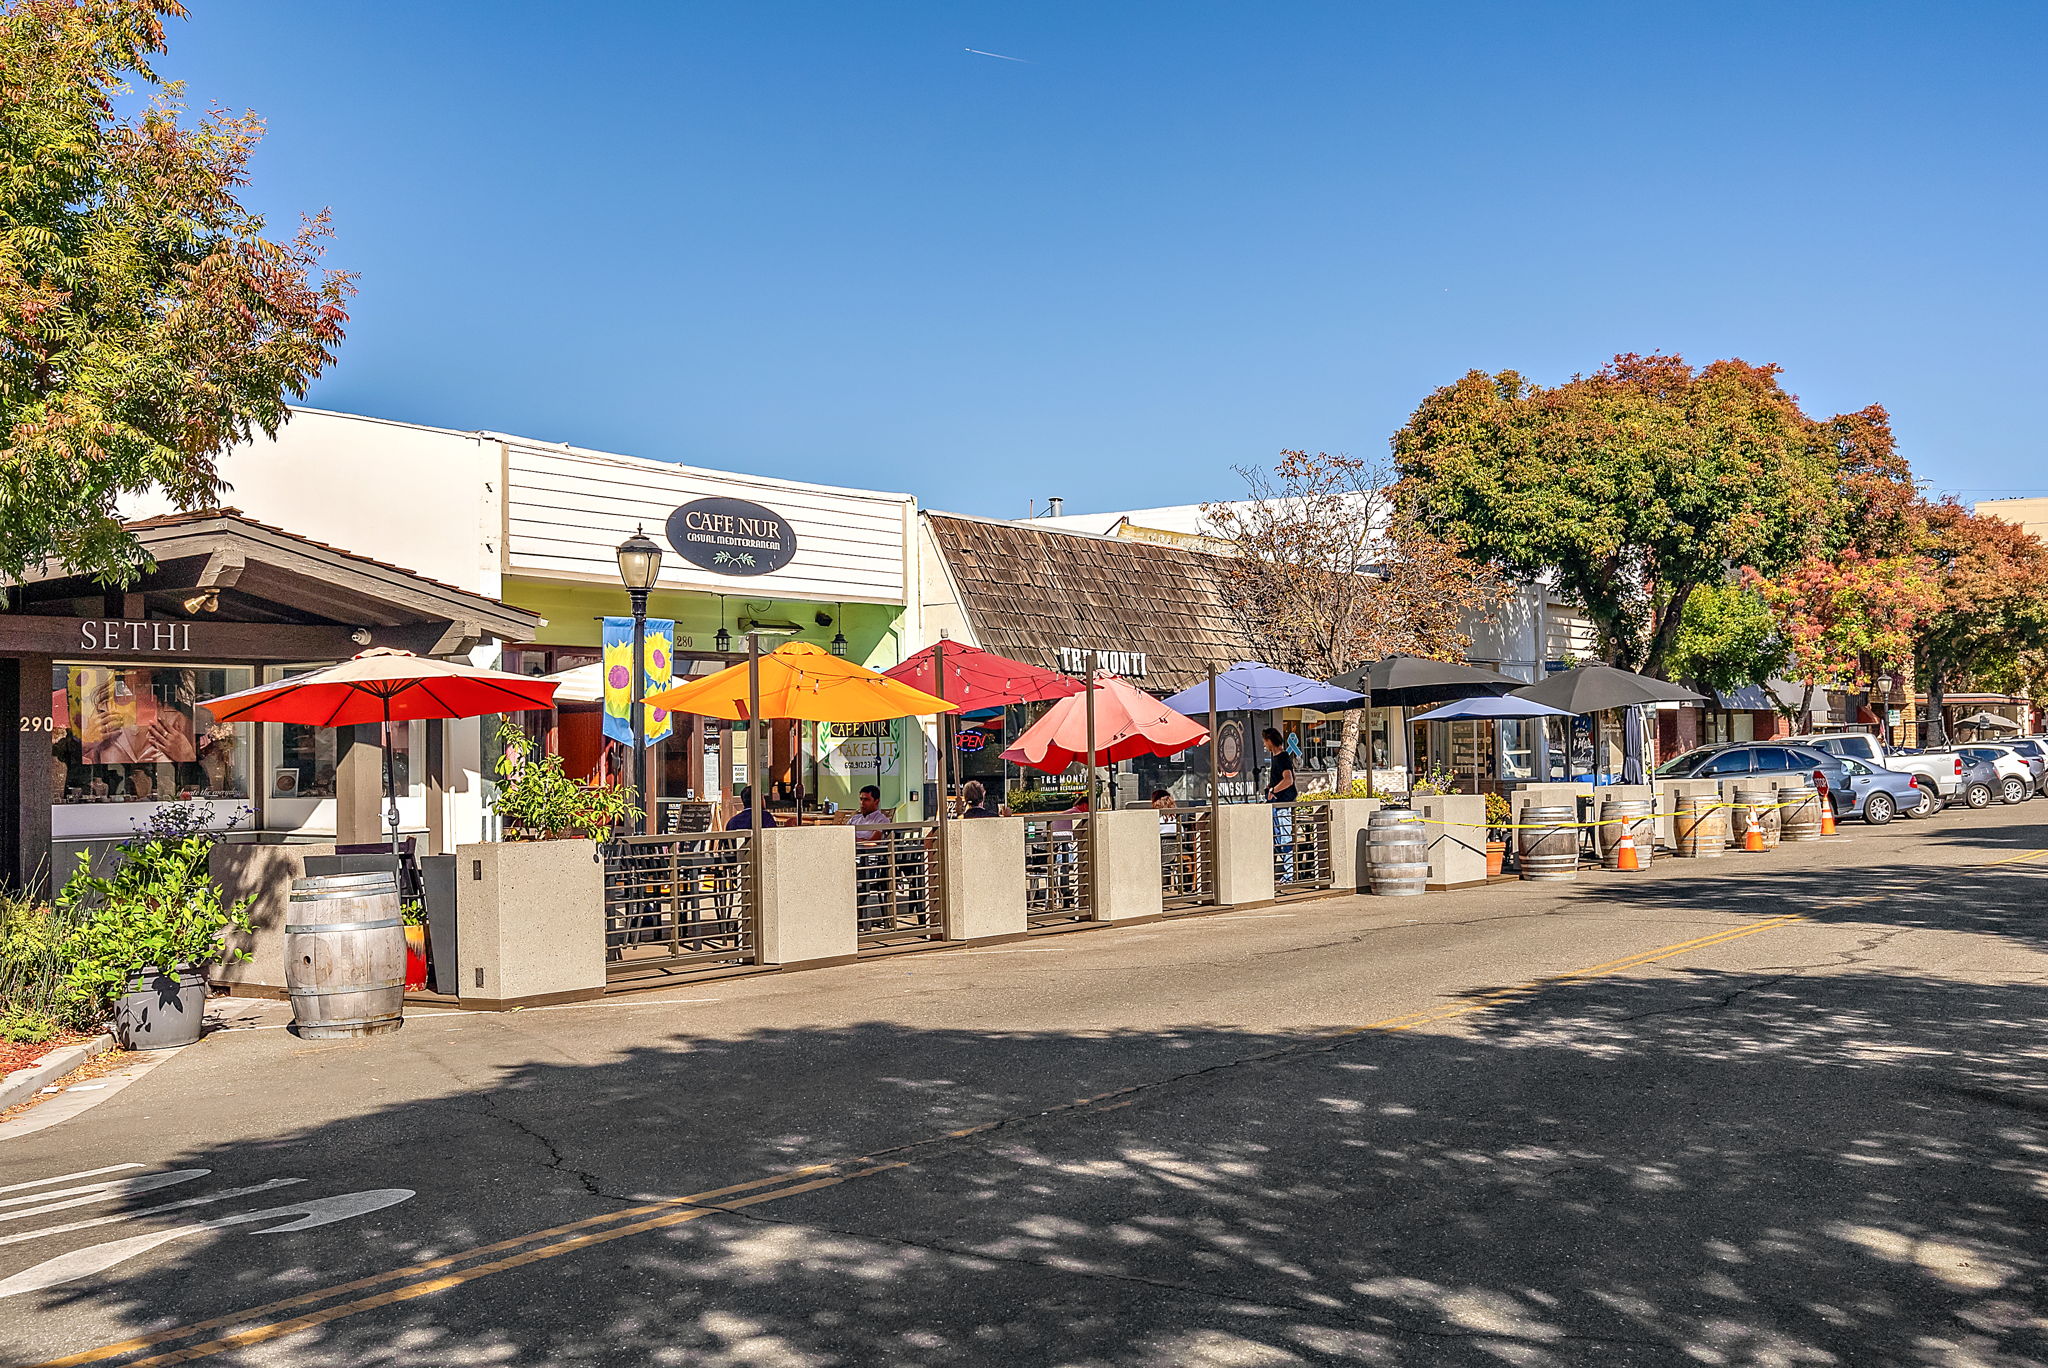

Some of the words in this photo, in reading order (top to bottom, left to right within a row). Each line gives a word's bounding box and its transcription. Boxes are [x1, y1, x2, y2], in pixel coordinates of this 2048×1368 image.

[685, 511, 734, 534] CAFE
[737, 517, 781, 539] NUR
[687, 532, 716, 543] CASUAL
[717, 535, 780, 551] MEDITERRANEAN
[80, 620, 191, 651] SETHI
[676, 635, 693, 648] 280
[1096, 650, 1148, 676] MONTI
[20, 716, 54, 732] 290
[830, 722, 860, 737] CAFE
[862, 720, 888, 737] NUR
[955, 734, 987, 748] OPEN
[1041, 775, 1057, 784] TRE
[1060, 773, 1087, 784] MONTI
[1814, 777, 1828, 788] STOP
[1206, 782, 1234, 798] CMING
[1235, 781, 1254, 796] SOON
